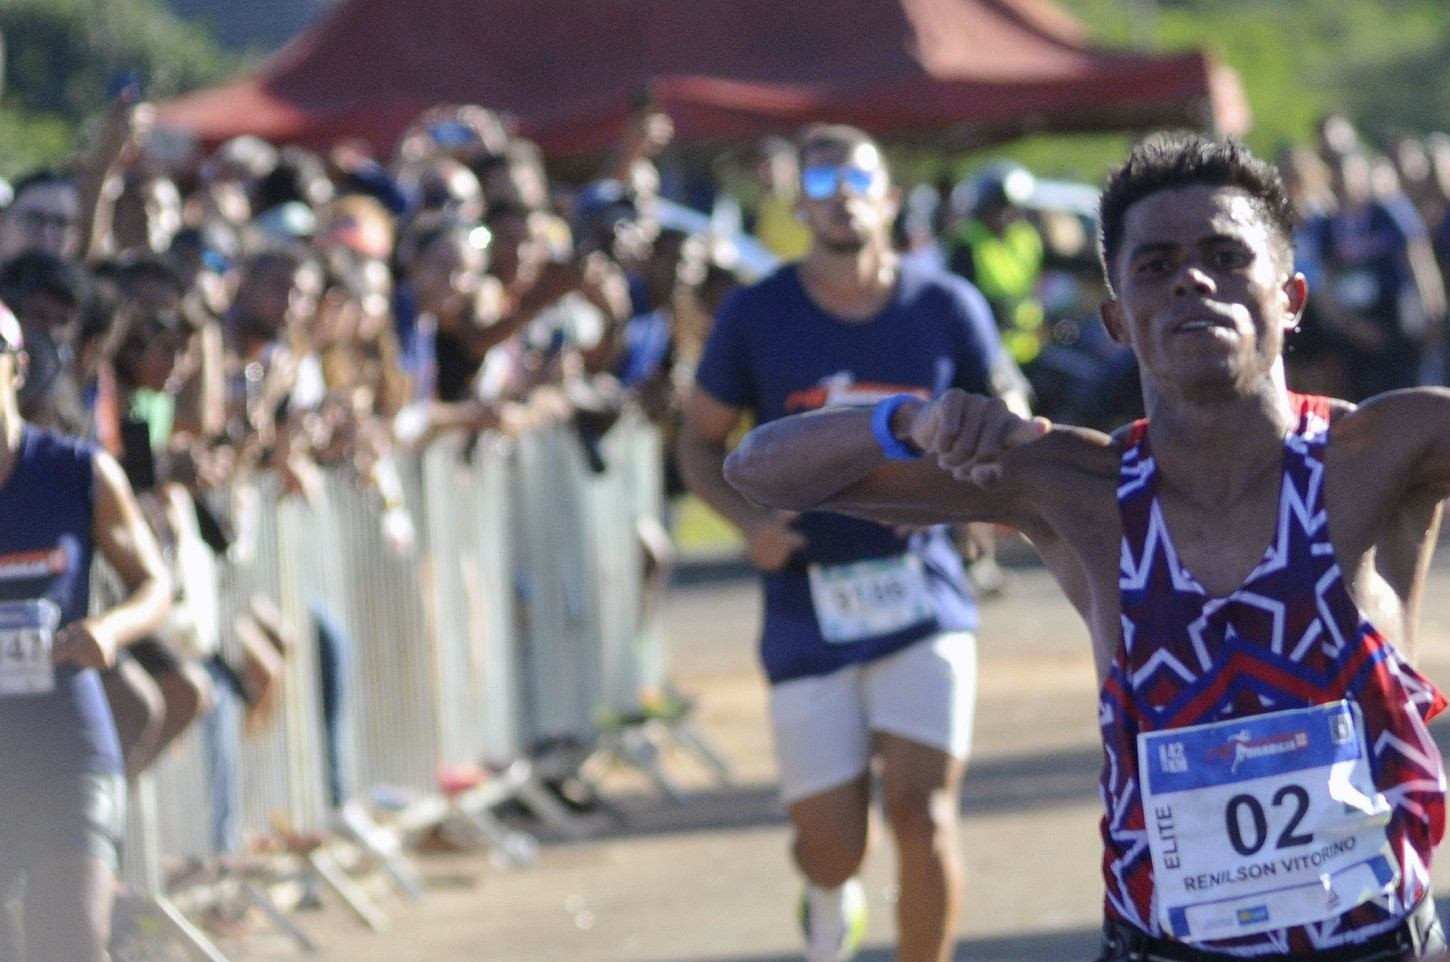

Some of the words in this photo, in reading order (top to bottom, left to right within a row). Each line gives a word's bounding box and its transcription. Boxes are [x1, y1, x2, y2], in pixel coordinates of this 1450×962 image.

[1155, 805, 1180, 869] ELITE
[1225, 784, 1314, 857] 02
[1184, 862, 1277, 892] RENILSON
[1281, 837, 1356, 872] VITORINO
